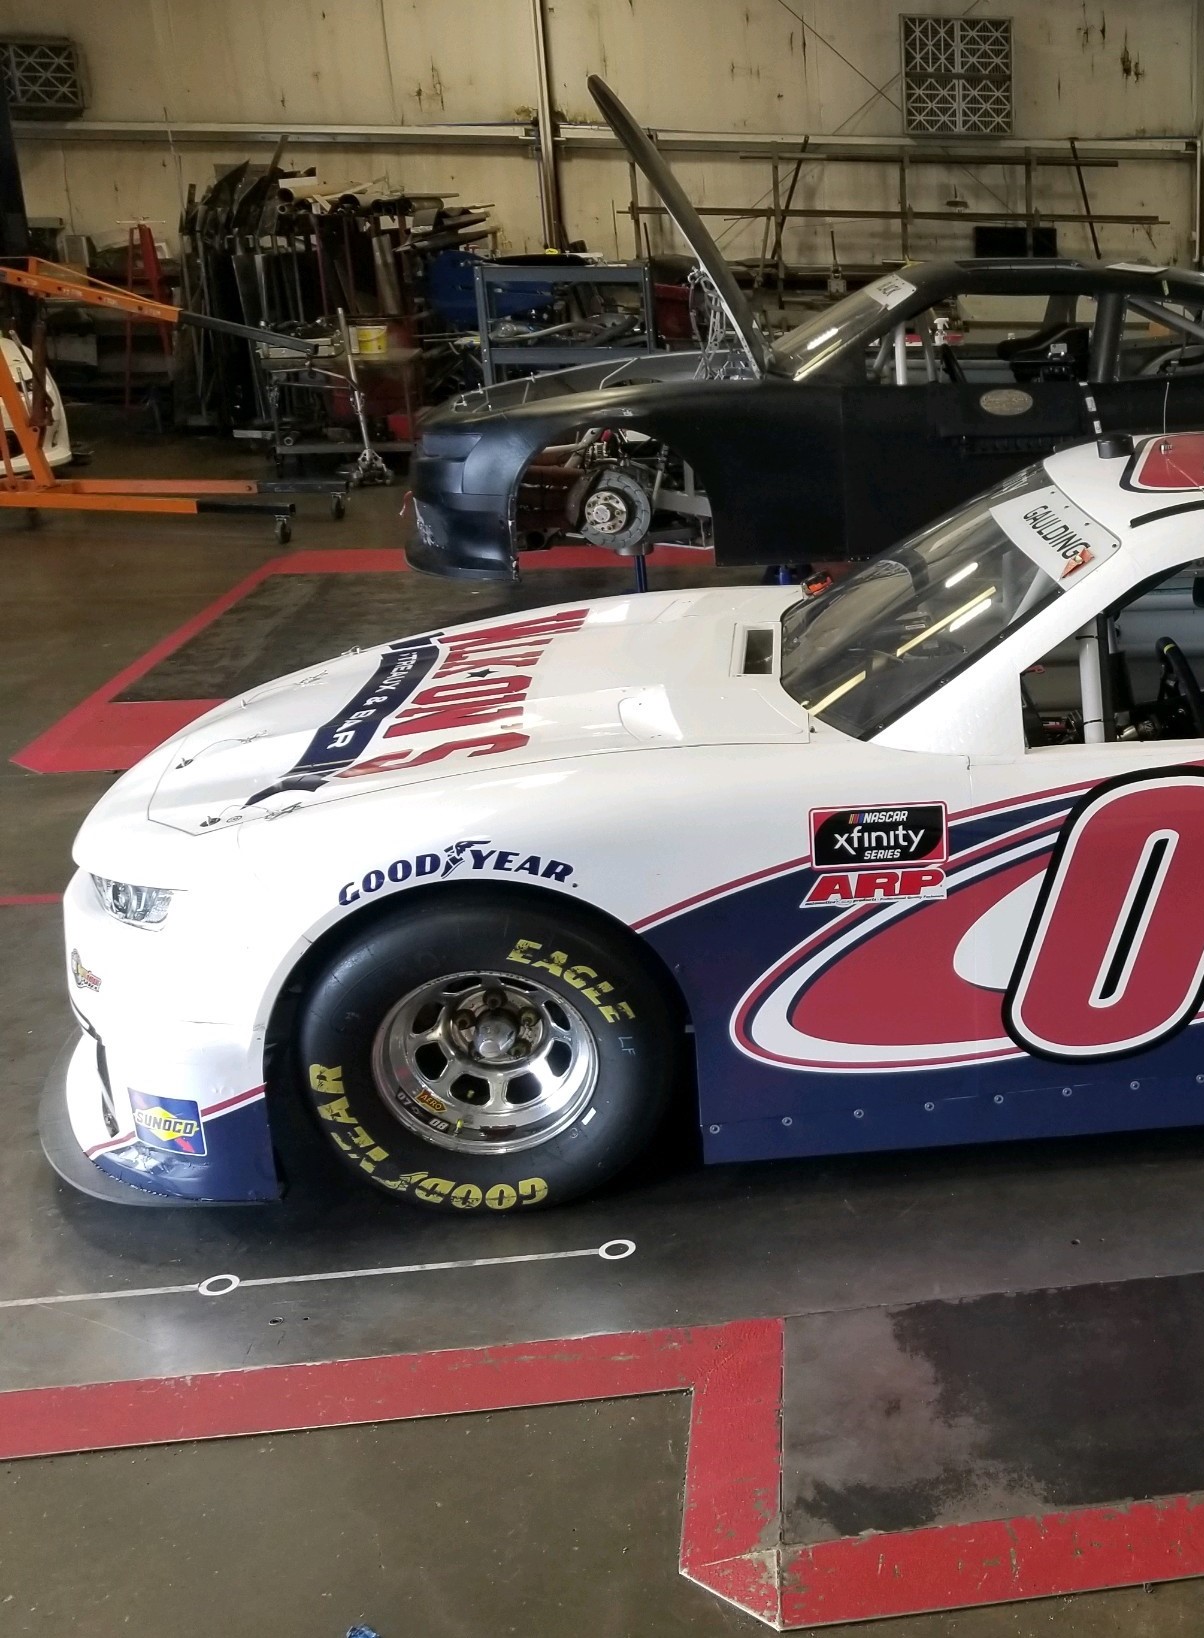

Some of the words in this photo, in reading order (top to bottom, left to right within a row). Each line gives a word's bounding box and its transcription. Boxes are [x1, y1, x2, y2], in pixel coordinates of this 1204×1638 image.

[1022, 504, 1091, 560] GAULDING
[863, 810, 908, 824] NASCAR
[833, 825, 926, 856] xfinity
[863, 849, 900, 860] SERIES
[338, 840, 579, 906] GOODYEAR
[806, 869, 945, 902] ARP
[506, 938, 636, 1024] EAGLE
[420, 1094, 443, 1111] AERO
[136, 1112, 193, 1135] SUNOCO
